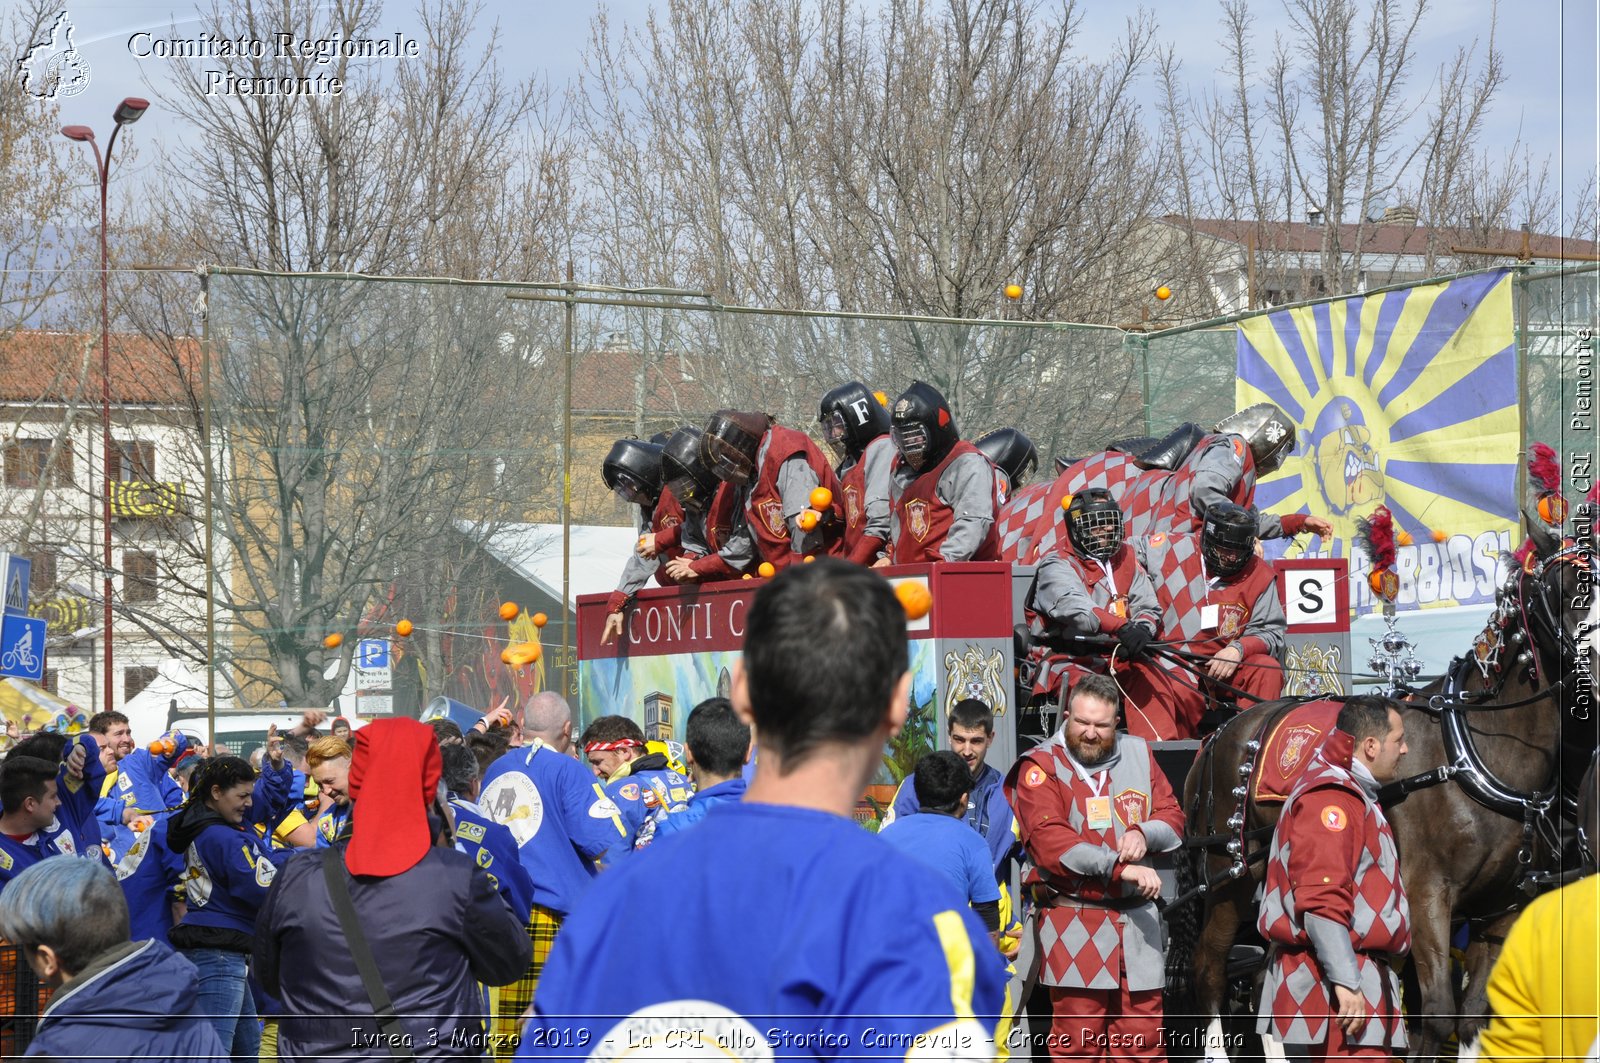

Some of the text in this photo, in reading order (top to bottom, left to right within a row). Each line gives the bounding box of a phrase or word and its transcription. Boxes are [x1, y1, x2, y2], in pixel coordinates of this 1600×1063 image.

[850, 397, 869, 426] F
[1349, 529, 1511, 607] RBBIOSI
[1298, 578, 1324, 614] S
[628, 602, 713, 644] CONTI
[366, 643, 383, 665] P
